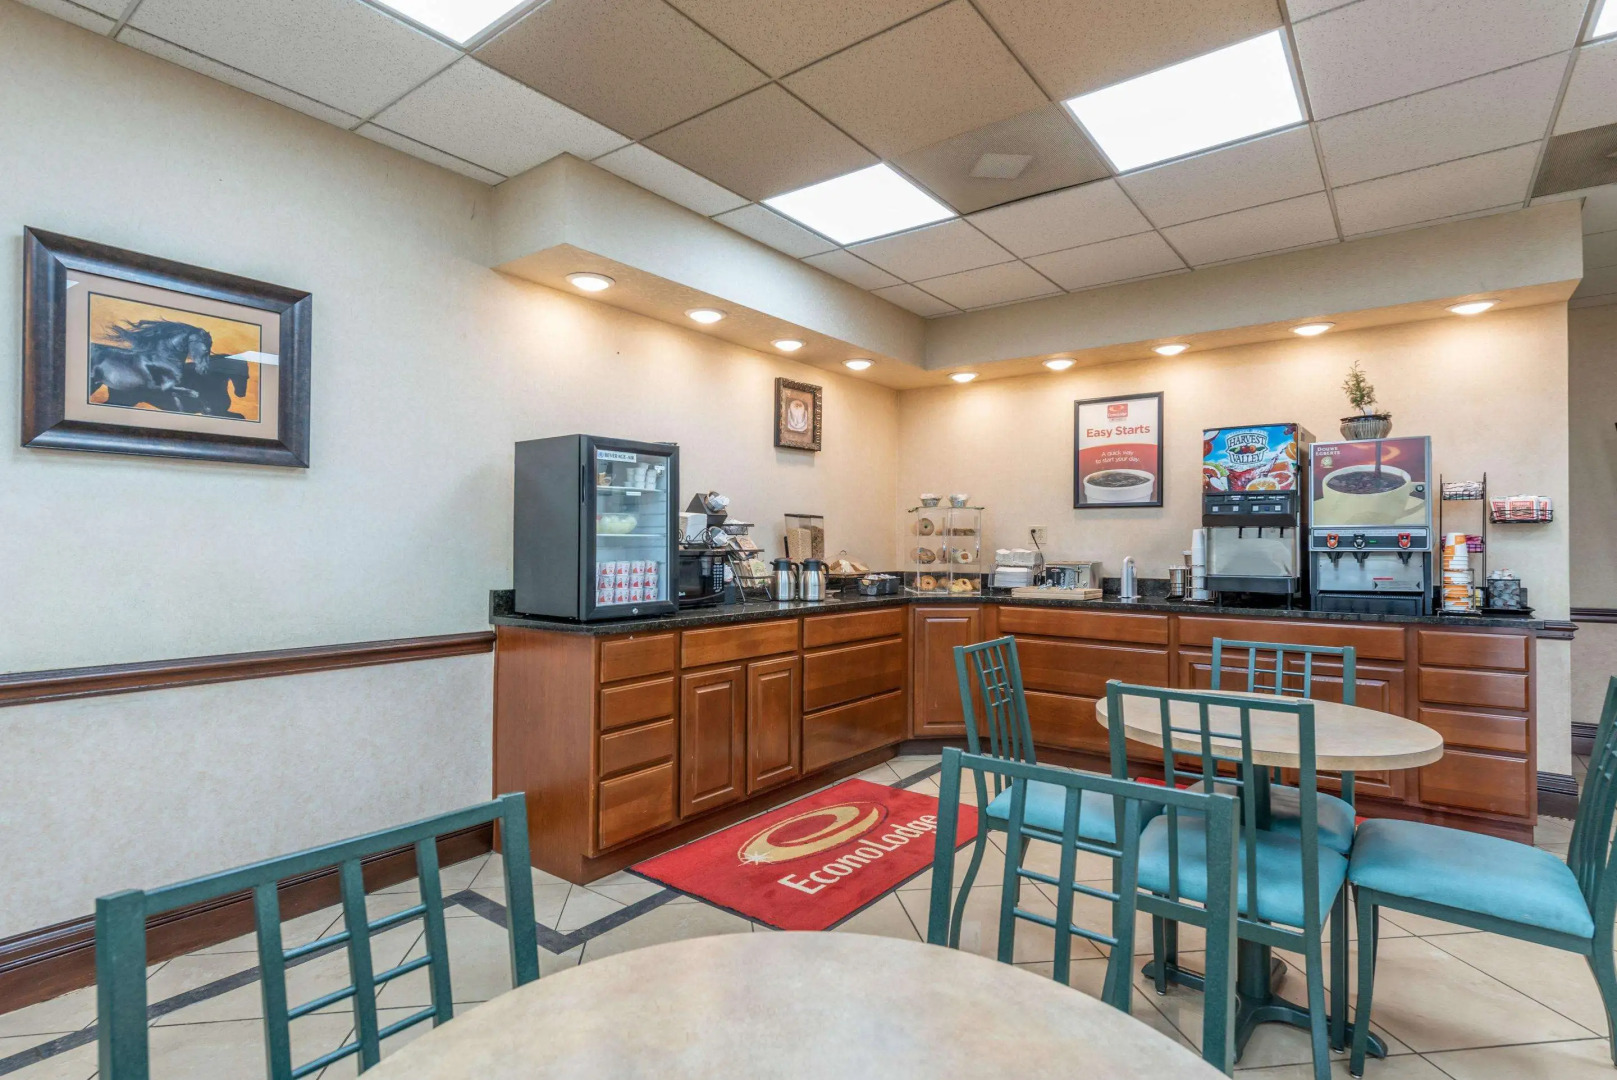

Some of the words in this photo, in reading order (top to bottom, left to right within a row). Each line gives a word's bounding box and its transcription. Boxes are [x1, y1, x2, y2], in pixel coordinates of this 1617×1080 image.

[1086, 428, 1113, 438] Easy
[1115, 424, 1150, 435] Starts
[1229, 434, 1266, 447] HARVEST
[1231, 452, 1262, 463] VALLEY
[776, 814, 939, 896] EconoLodge
